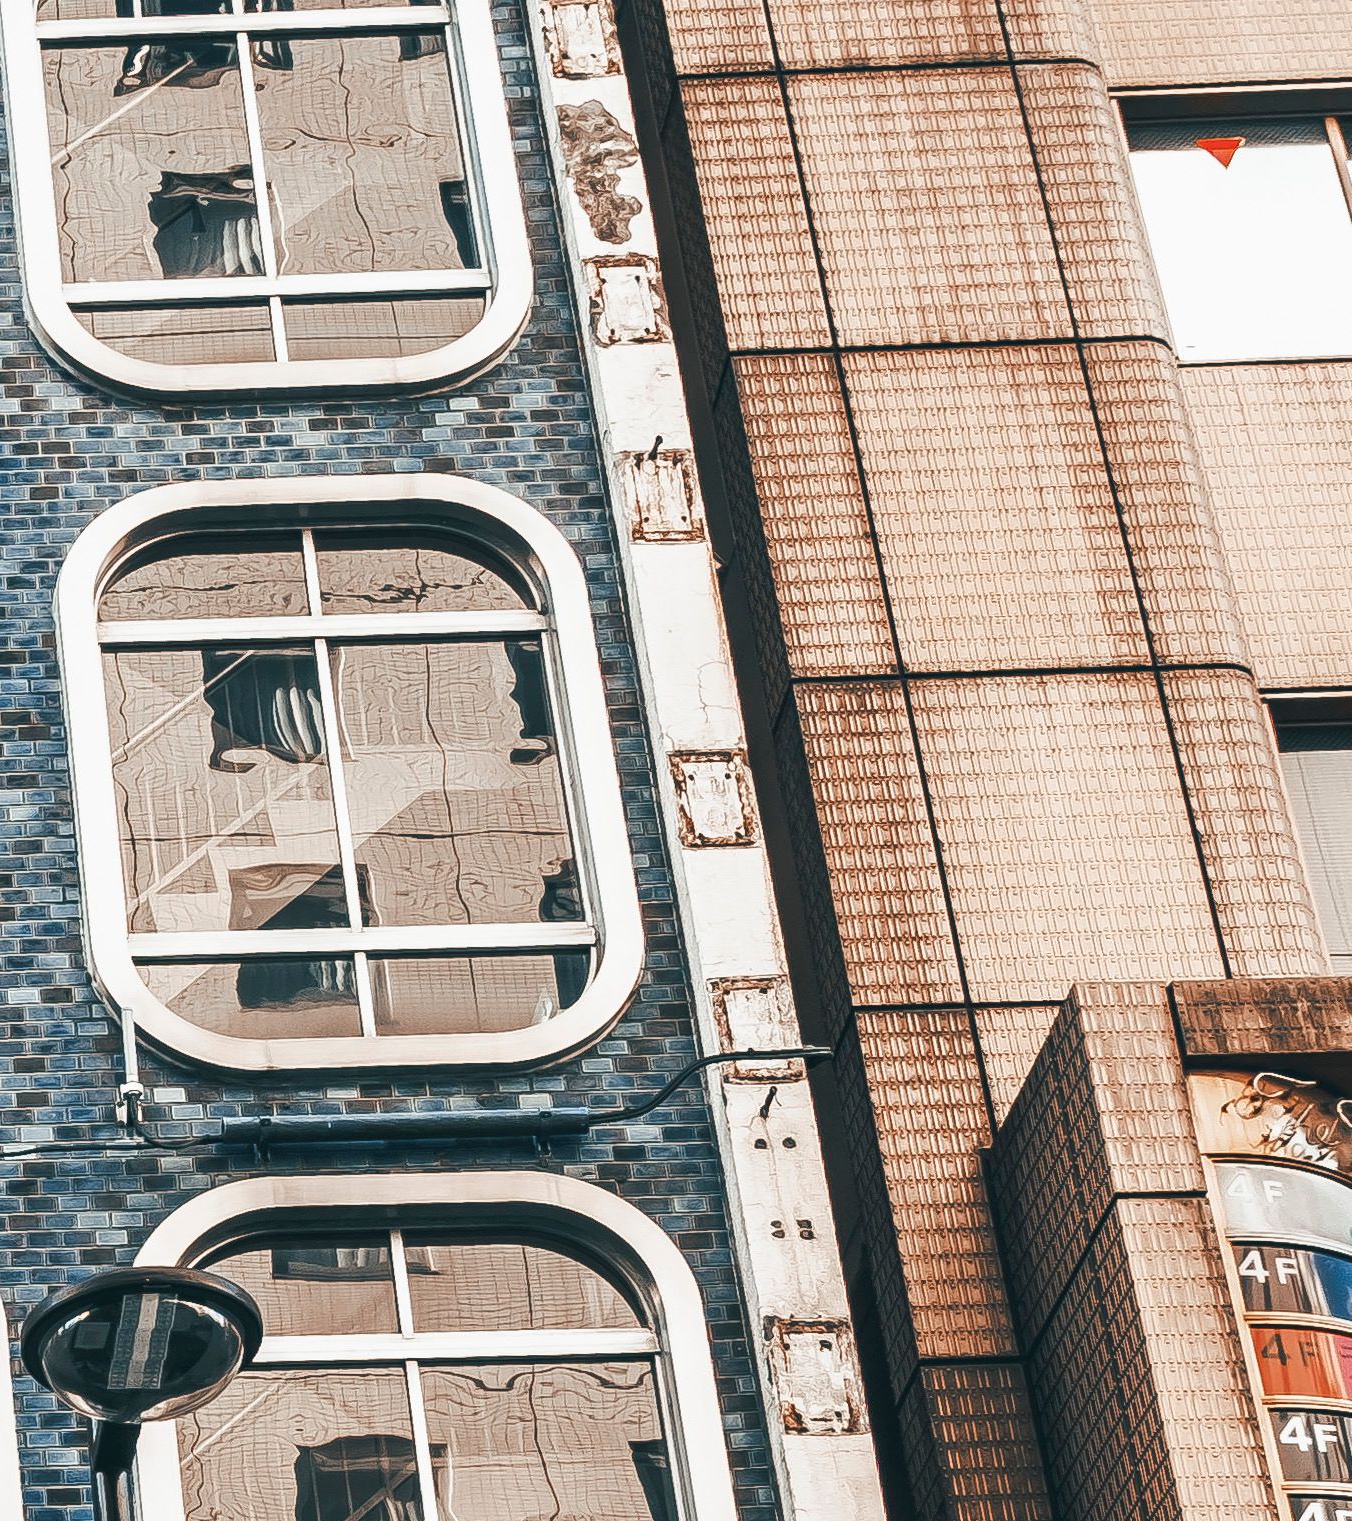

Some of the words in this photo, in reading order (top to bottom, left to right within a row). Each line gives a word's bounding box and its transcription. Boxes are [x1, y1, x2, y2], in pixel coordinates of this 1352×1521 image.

[1239, 1250, 1297, 1285] 4F
[1262, 1334, 1316, 1367] 4F
[1280, 1415, 1337, 1453] 4F
